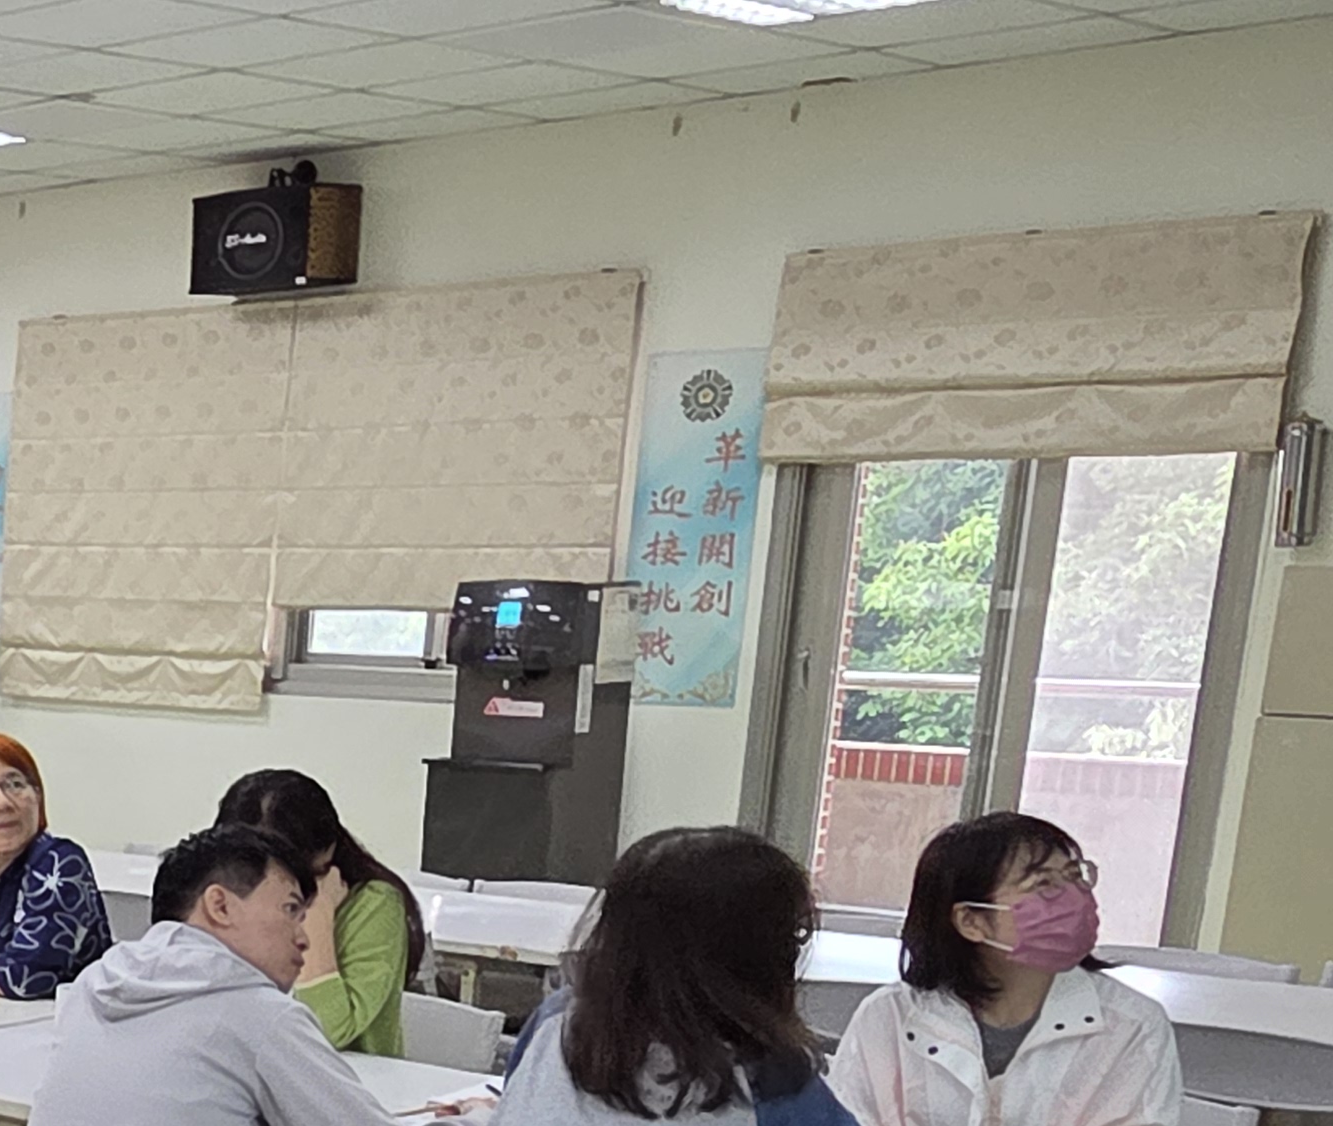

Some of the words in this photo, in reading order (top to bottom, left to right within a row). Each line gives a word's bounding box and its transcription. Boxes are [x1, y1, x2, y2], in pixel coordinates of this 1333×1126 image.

[636, 484, 693, 667] 迎接挑戰
[689, 428, 746, 618] 革新開創
